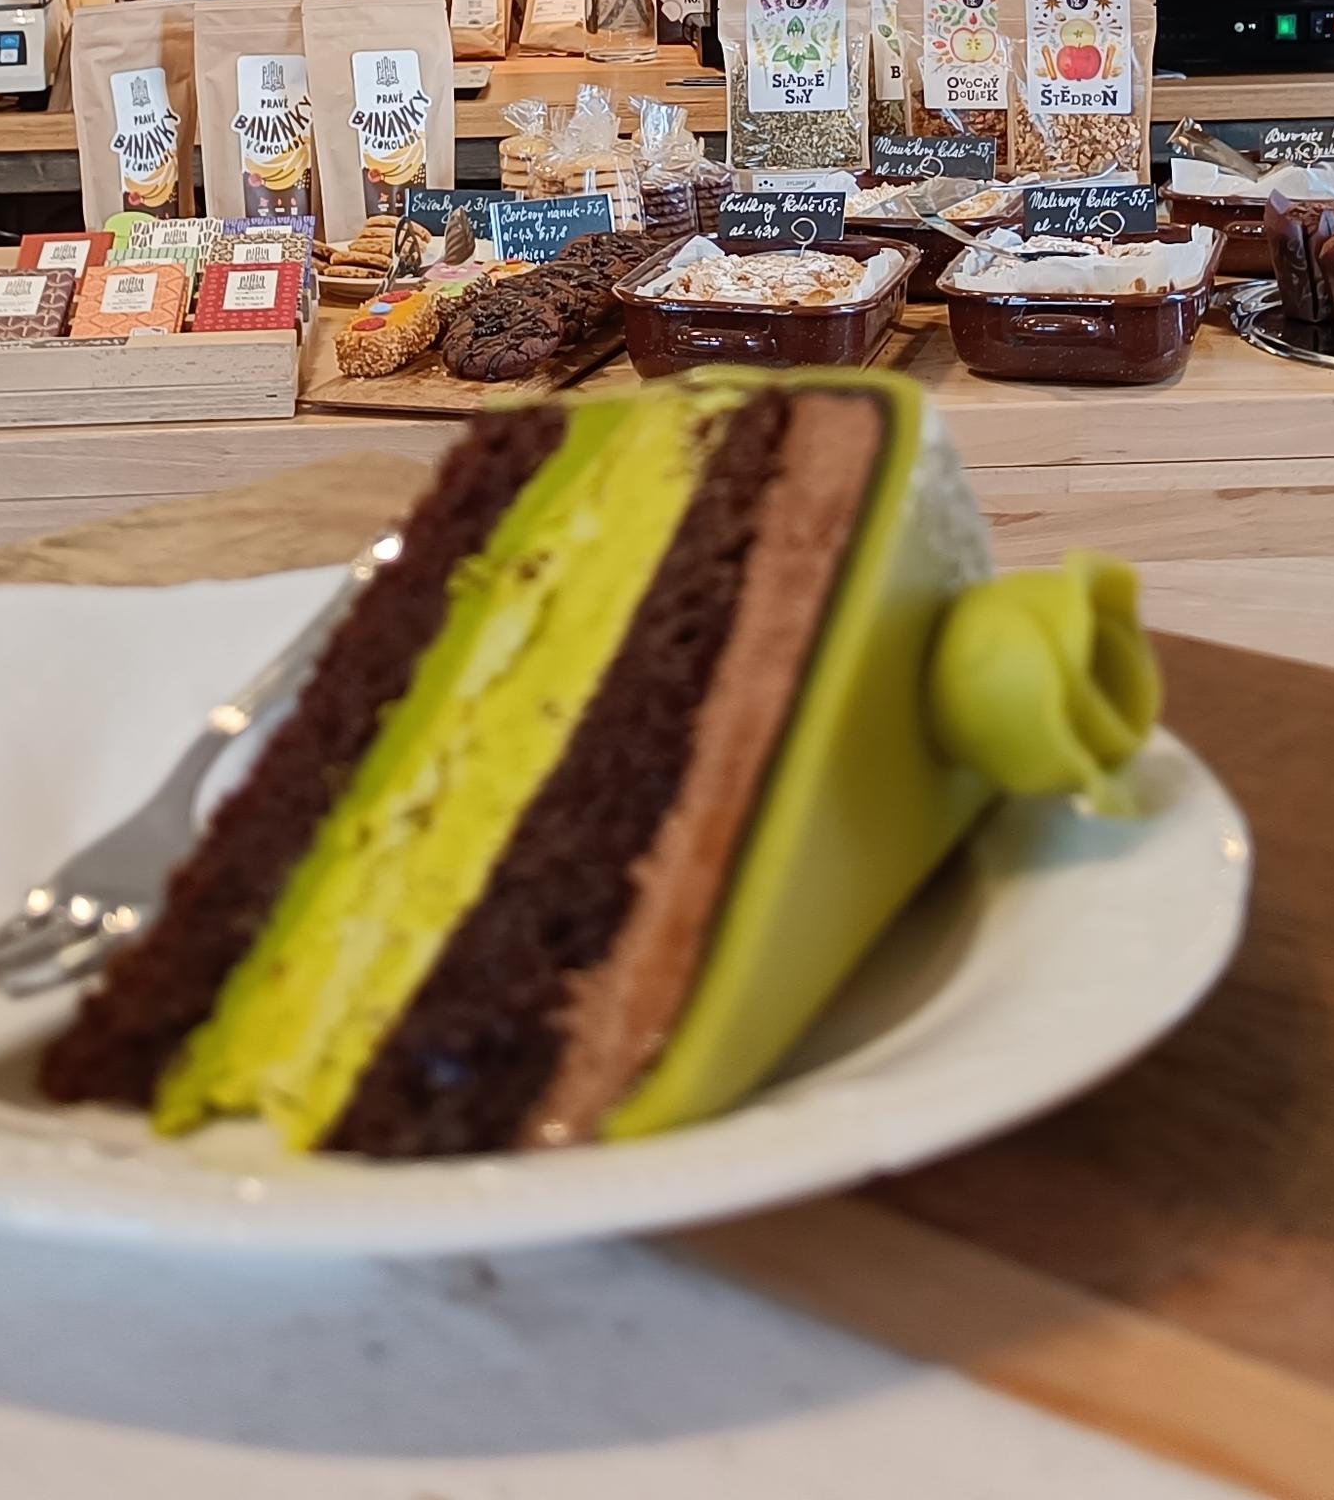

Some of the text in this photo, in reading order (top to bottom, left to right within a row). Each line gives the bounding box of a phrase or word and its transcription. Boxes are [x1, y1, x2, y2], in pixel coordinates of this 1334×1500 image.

[772, 70, 825, 89] SLADKÉ
[946, 71, 1001, 90] OVOCNÝ
[261, 95, 289, 109] PRAVÉ
[376, 90, 404, 105] PRAVÉ
[784, 87, 813, 105] SNY
[1040, 83, 1119, 107] ŠTĚDROŇ
[133, 109, 157, 127] PRAVÉ
[234, 95, 312, 143] BANÁNKY
[352, 89, 430, 139] BANÁNKY
[113, 107, 179, 160] BANÁNKY
[1029, 188, 1085, 220] Malinový
[1085, 188, 1121, 209] koláč
